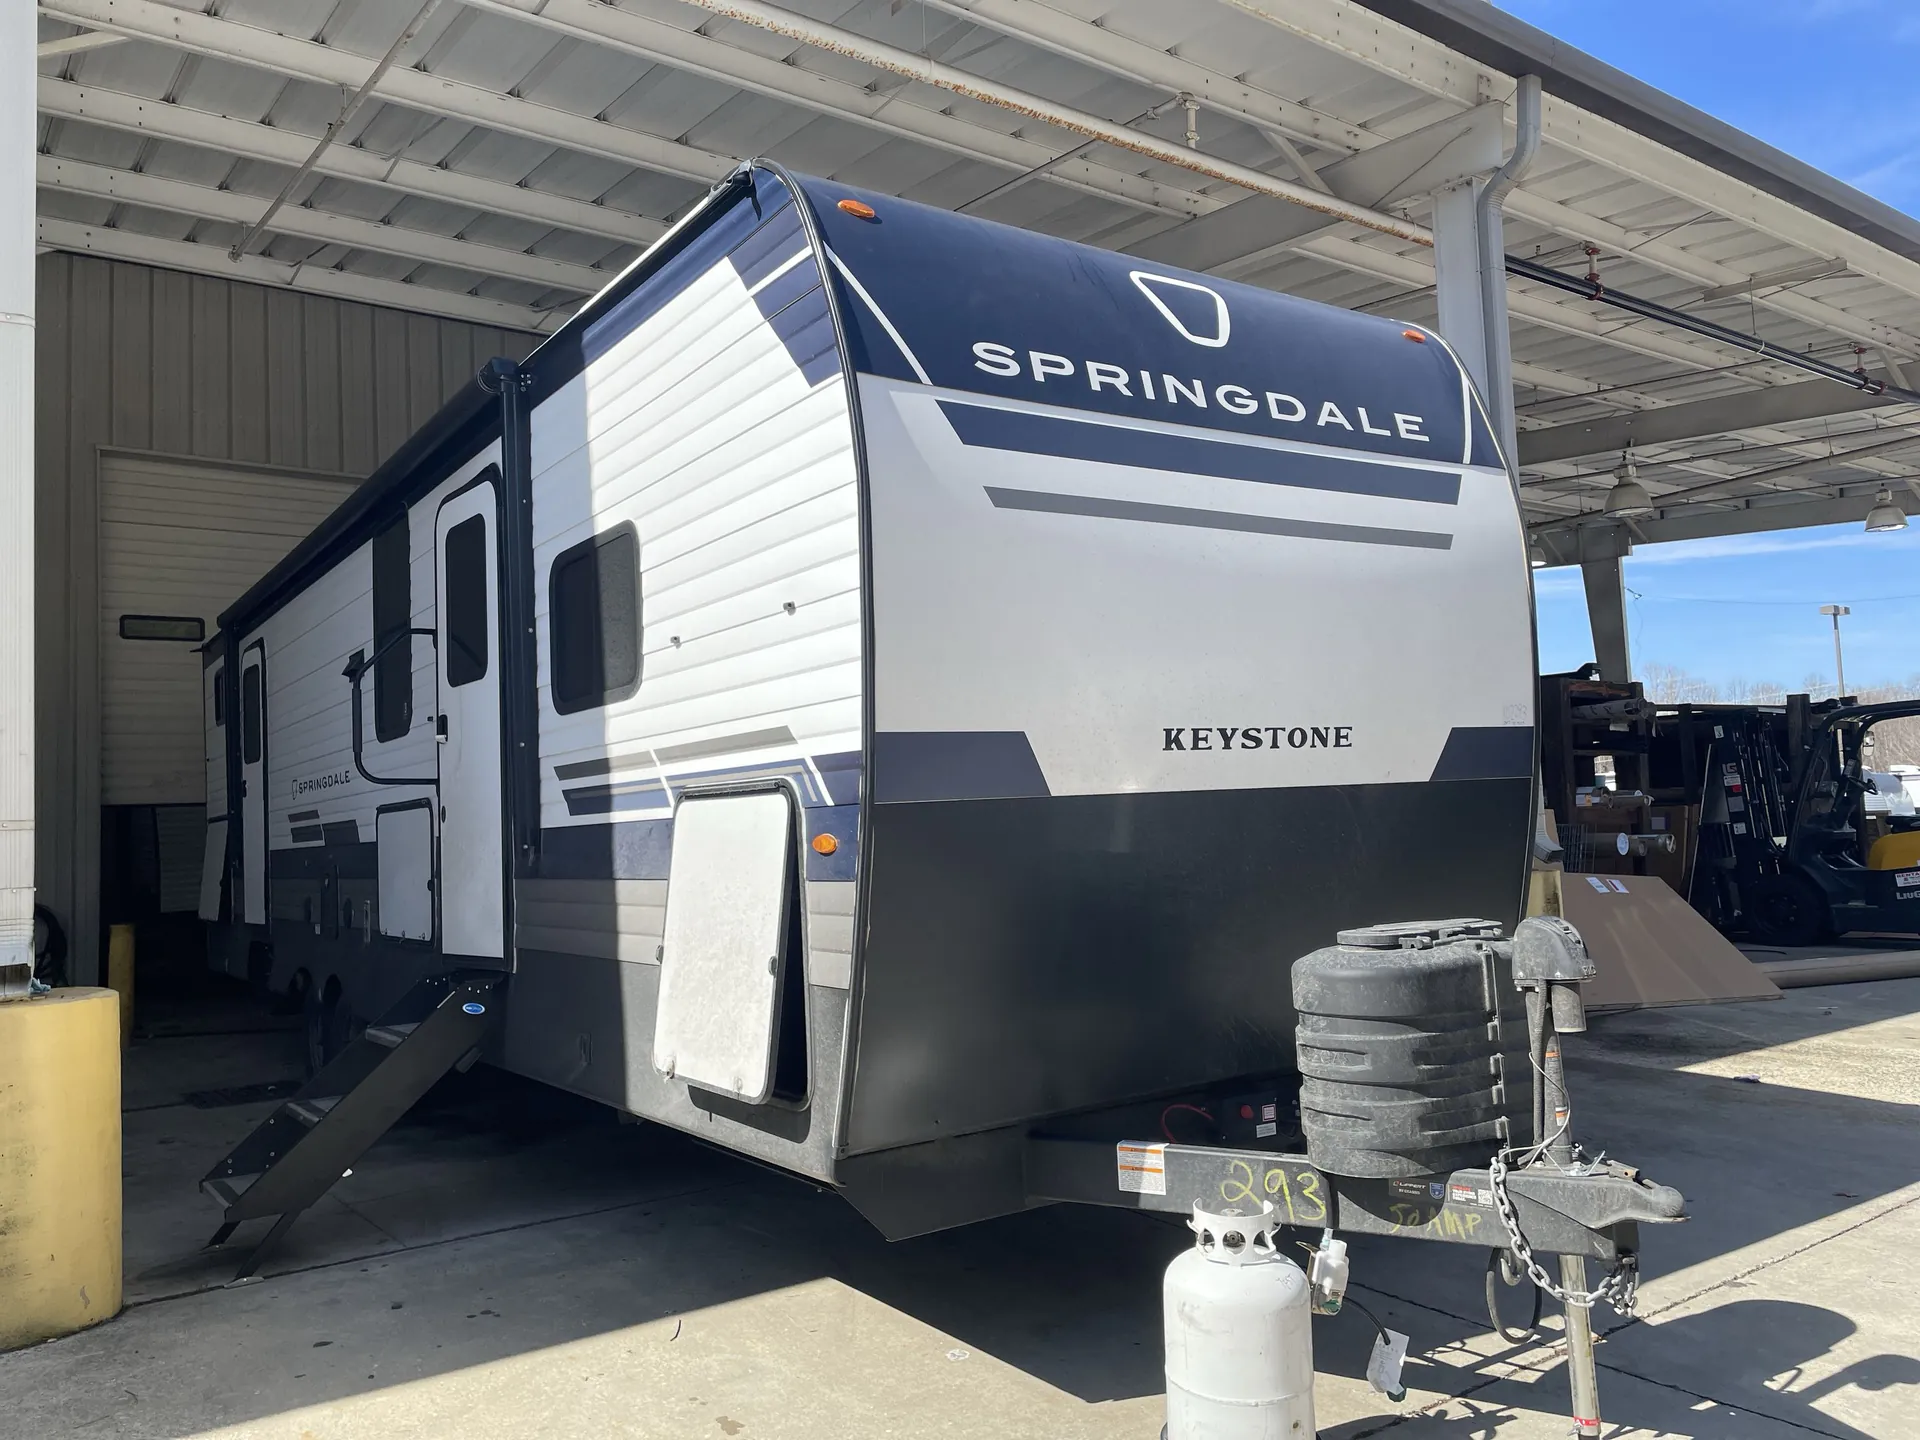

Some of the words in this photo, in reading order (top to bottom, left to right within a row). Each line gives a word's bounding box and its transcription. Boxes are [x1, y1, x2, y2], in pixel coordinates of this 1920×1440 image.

[972, 342, 1430, 442] SPRINGDALE
[1162, 726, 1353, 751] KEYSTONE
[298, 770, 351, 794] SPRINGDALE
[1220, 1158, 1327, 1223] 293
